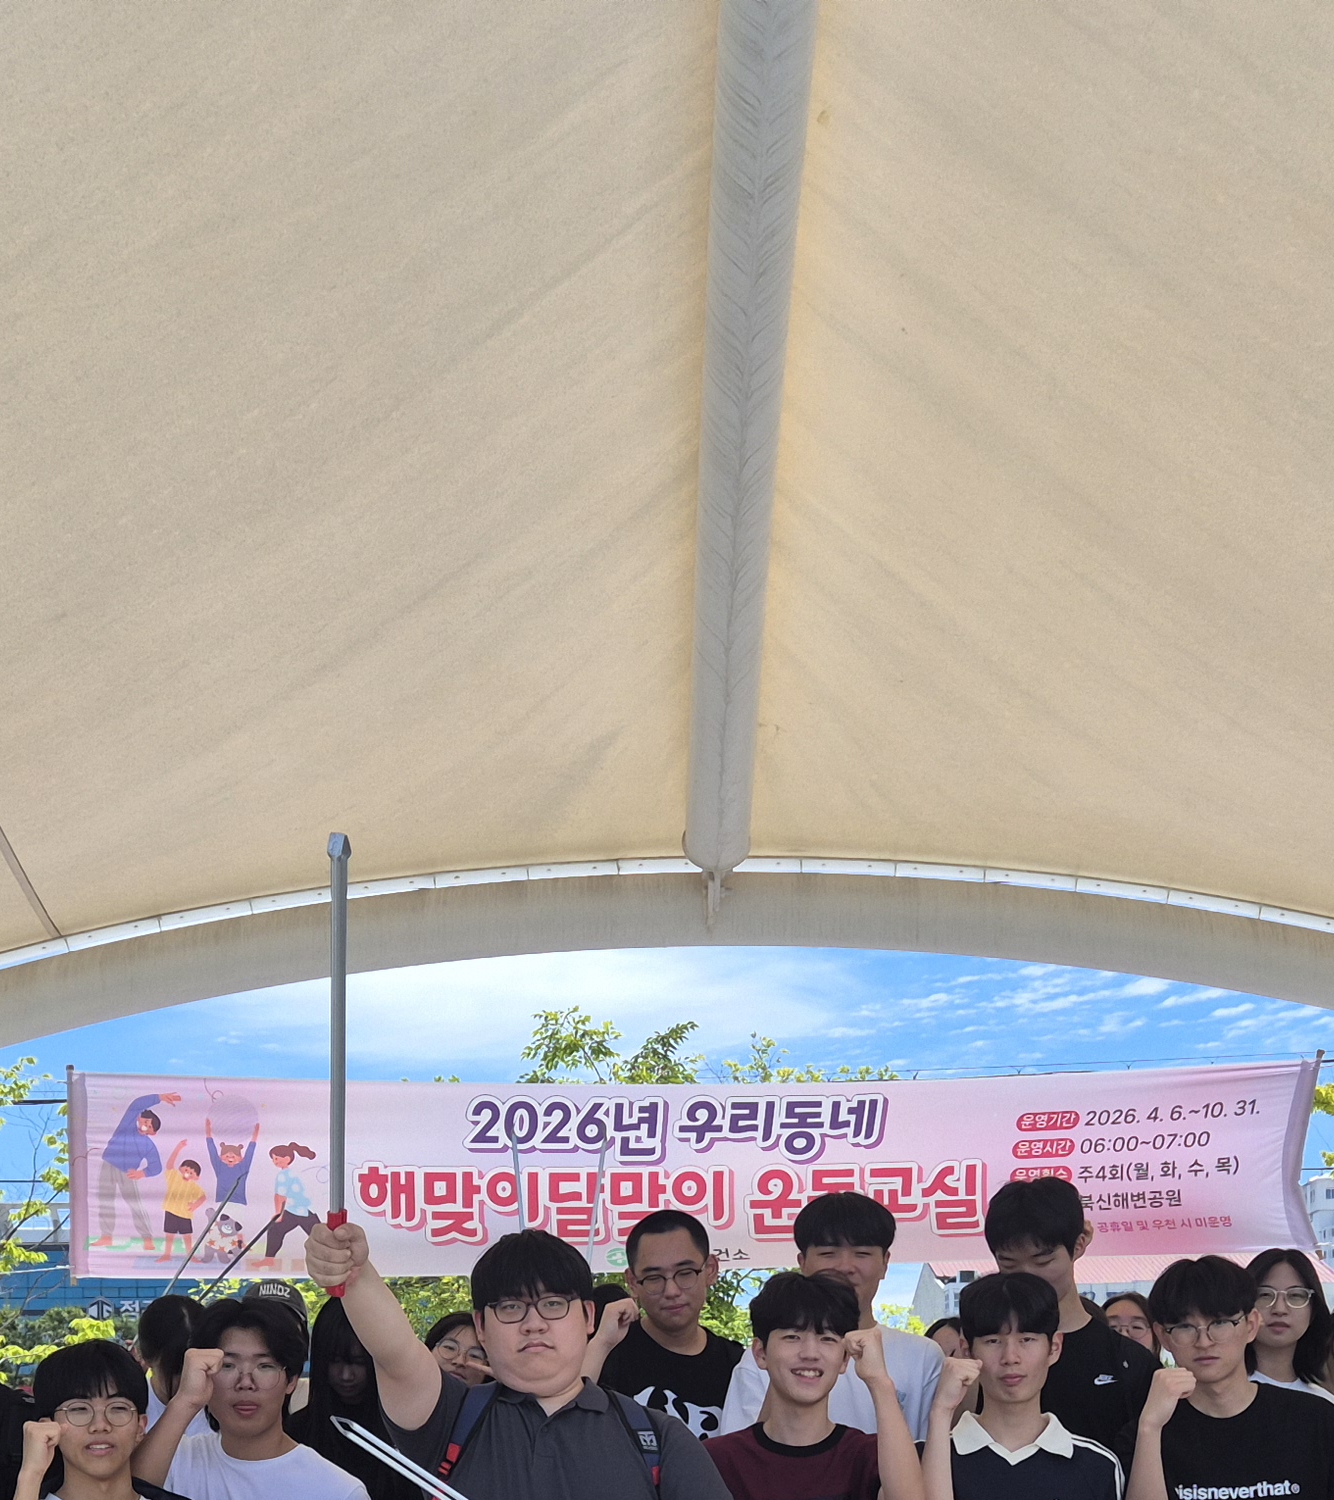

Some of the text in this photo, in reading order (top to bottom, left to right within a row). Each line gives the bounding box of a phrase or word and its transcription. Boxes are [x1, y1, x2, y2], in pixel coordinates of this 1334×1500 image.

[1020, 1113, 1076, 1129] 운영기간
[1084, 1108, 1140, 1126] 2026.
[1146, 1106, 1164, 1122] 4.
[1233, 1098, 1260, 1116] 31.
[469, 1098, 880, 1156] 2026년 우리동네
[1016, 1131, 1211, 1156] 운영시간 06:00~07:00
[1160, 1161, 1182, 1180] 화,
[1187, 1158, 1209, 1178] 수,
[1215, 1155, 1240, 1175] 목)
[1097, 1215, 1233, 1233] 공휴일 및 우천 시 미운영
